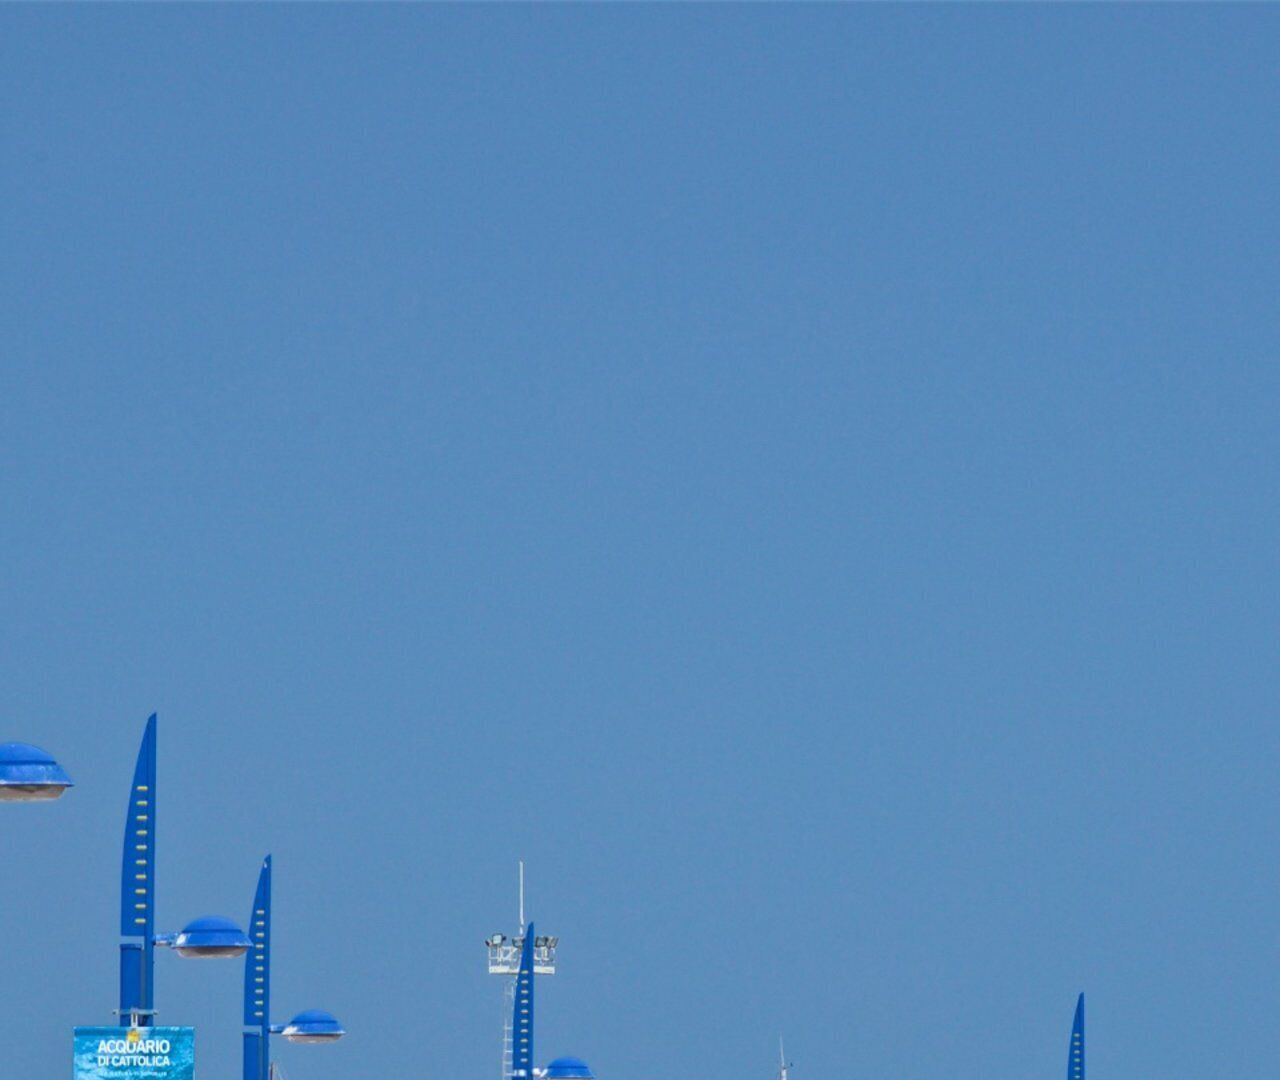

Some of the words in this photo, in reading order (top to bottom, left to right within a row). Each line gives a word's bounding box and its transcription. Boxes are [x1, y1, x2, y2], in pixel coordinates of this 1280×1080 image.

[97, 1039, 171, 1055] ACQUARIO
[98, 1055, 109, 1067] DI
[111, 1055, 171, 1067] CATTOLICA
